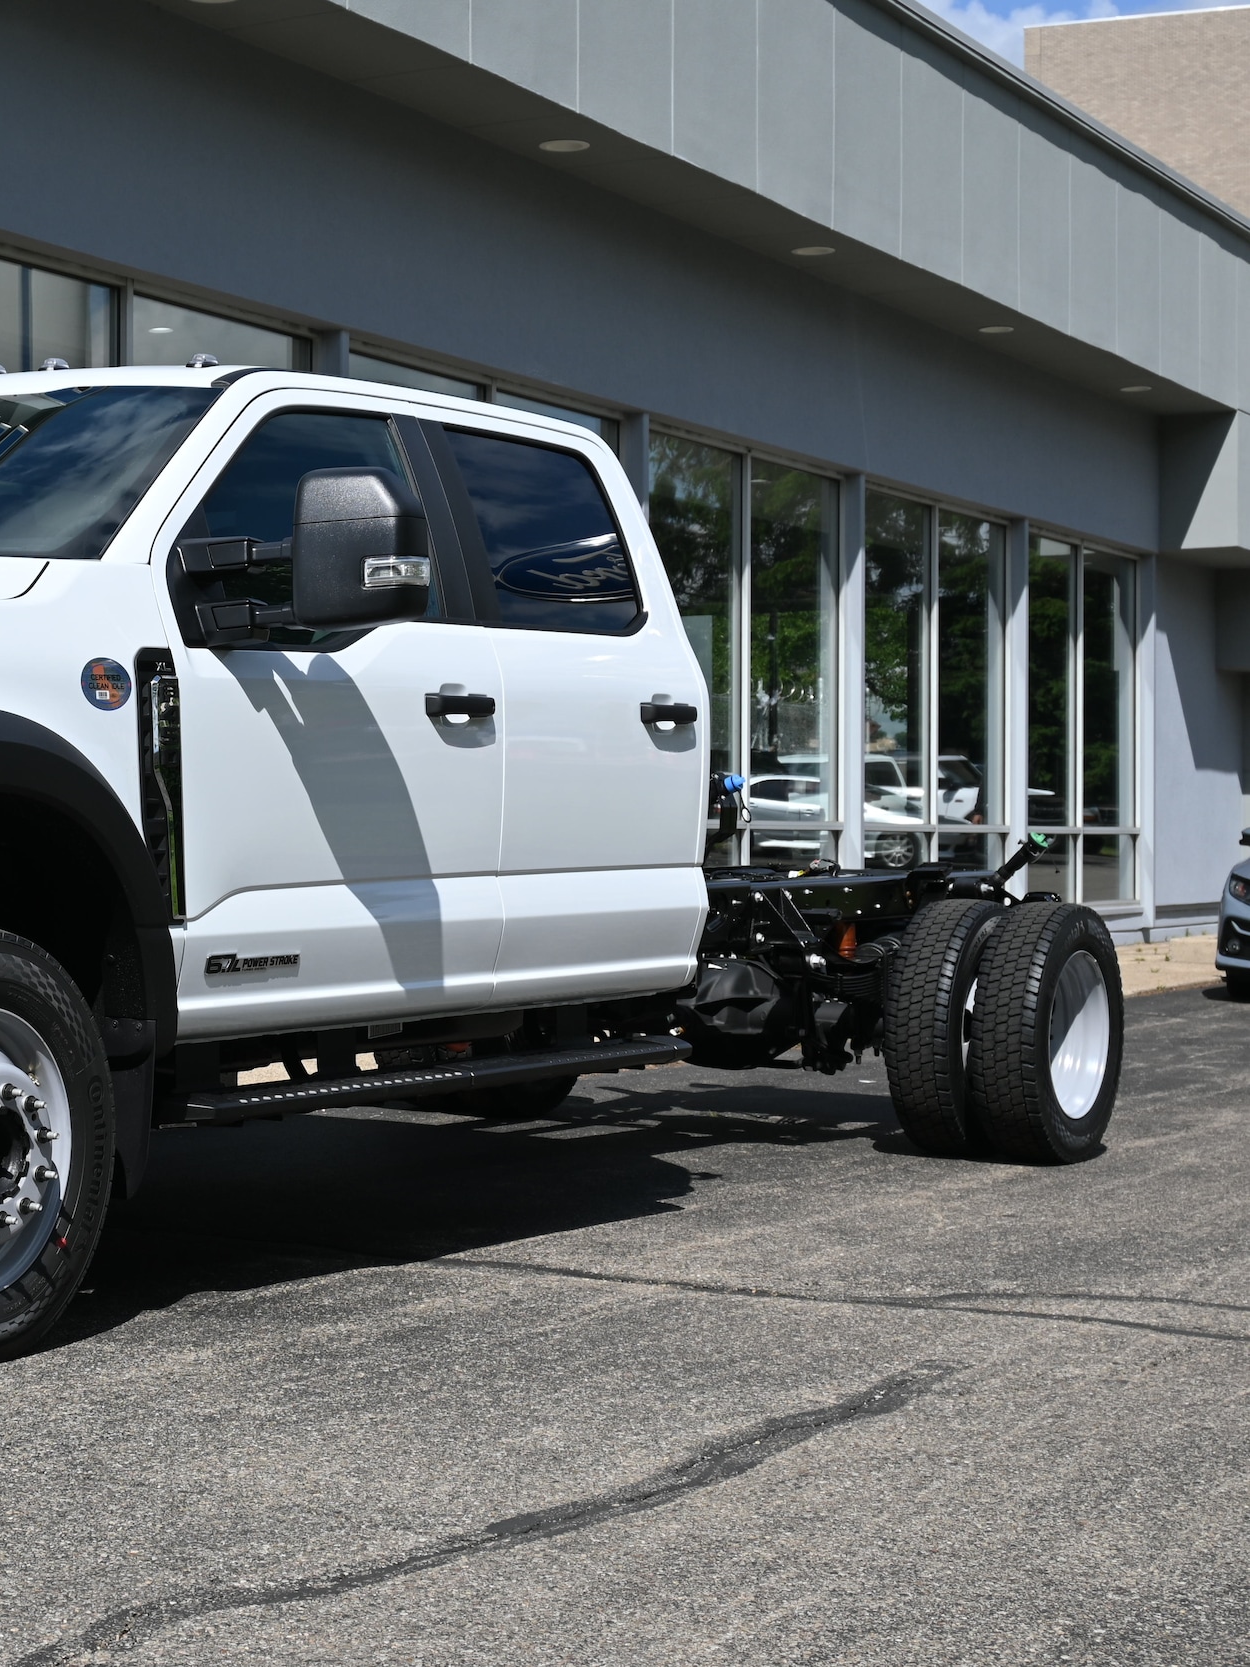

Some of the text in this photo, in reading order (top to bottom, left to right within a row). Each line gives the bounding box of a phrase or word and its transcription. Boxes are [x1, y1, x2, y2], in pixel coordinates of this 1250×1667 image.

[155, 661, 172, 671] XL
[88, 682, 109, 690] CLEAN
[205, 953, 242, 975] 6.7L
[242, 956, 269, 969] POWER
[269, 954, 299, 966] STROKE
[83, 1075, 107, 1236] Continental
